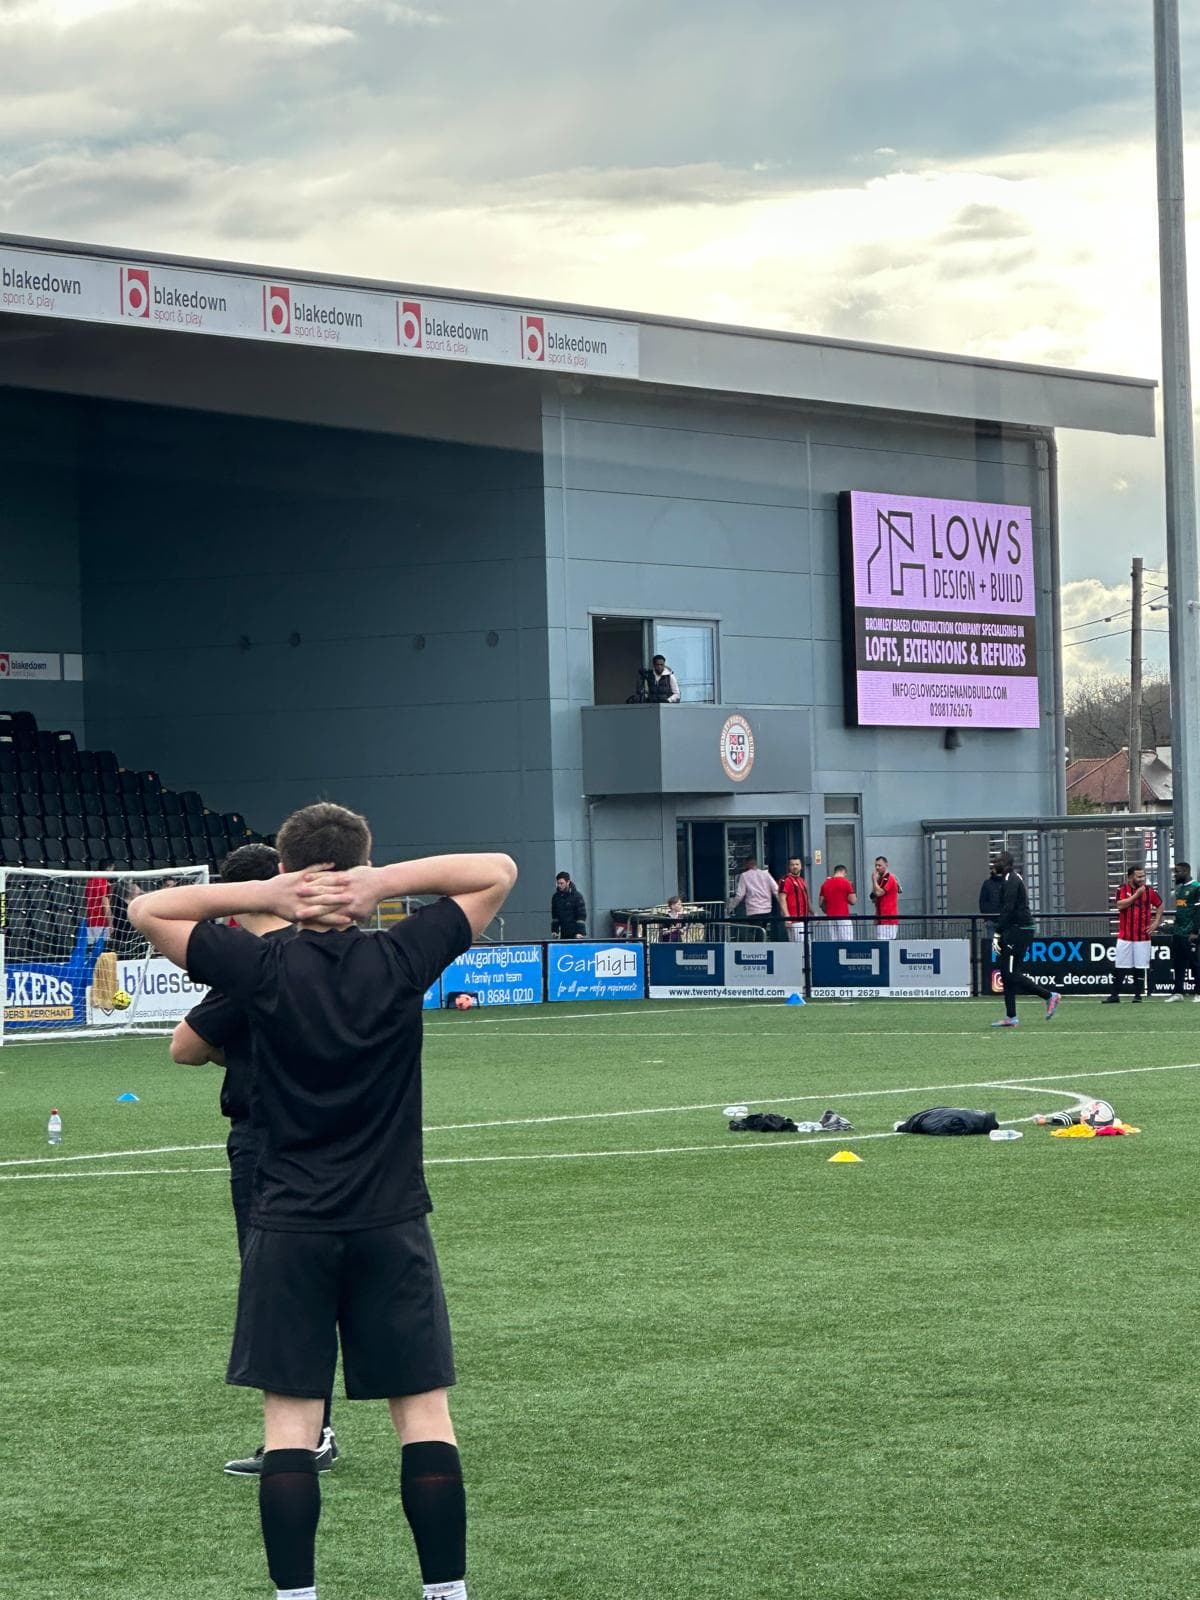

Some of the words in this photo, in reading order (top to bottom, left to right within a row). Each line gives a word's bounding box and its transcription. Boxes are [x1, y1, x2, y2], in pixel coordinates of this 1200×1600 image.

[3, 267, 81, 294] blakedown
[3, 293, 25, 305] sport
[27, 293, 34, 305] &
[37, 295, 55, 310] play
[154, 286, 227, 312] blakedown
[153, 310, 175, 322] sport
[177, 310, 184, 322] &
[186, 311, 203, 327] play
[294, 303, 362, 327] blakedown
[294, 326, 314, 337] sport
[316, 326, 323, 338] &
[325, 328, 340, 342] play
[425, 317, 489, 342] blakedown
[425, 341, 445, 352] sport
[446, 340, 453, 352] &
[454, 342, 468, 356] play
[547, 332, 607, 354] blakedown
[548, 354, 566, 365] sport
[574, 355, 588, 368] play
[930, 513, 1021, 564] LOWS
[933, 568, 976, 600] DESIGN
[990, 572, 1023, 603] BUILD
[865, 617, 891, 631] BROMLEY
[892, 619, 911, 632] BASED
[911, 620, 954, 634] CONSTRUCTION
[954, 622, 981, 636] COMPANY
[981, 623, 1017, 637] SPECIALISING
[1017, 625, 1024, 637] IN
[865, 636, 901, 667] LOFTS,
[903, 638, 967, 665] EXTENSIONS
[970, 642, 979, 666] &
[981, 642, 1026, 667] REFURBS
[892, 683, 1007, 700] INFO@LOWSDESIGNANDBUILD.COM
[930, 703, 973, 718] 02081762676
[451, 947, 540, 968] ww.garhigh.co.uk
[124, 966, 211, 995] bluese
[464, 973, 471, 984] A
[472, 972, 492, 985] family
[493, 974, 505, 983] run
[506, 972, 523, 981] team
[488, 989, 510, 1003] 8684
[513, 988, 534, 1002] 0210
[669, 988, 785, 997] www.twenty4sevenltd.com
[814, 989, 836, 997] 0203
[839, 989, 853, 997] 011
